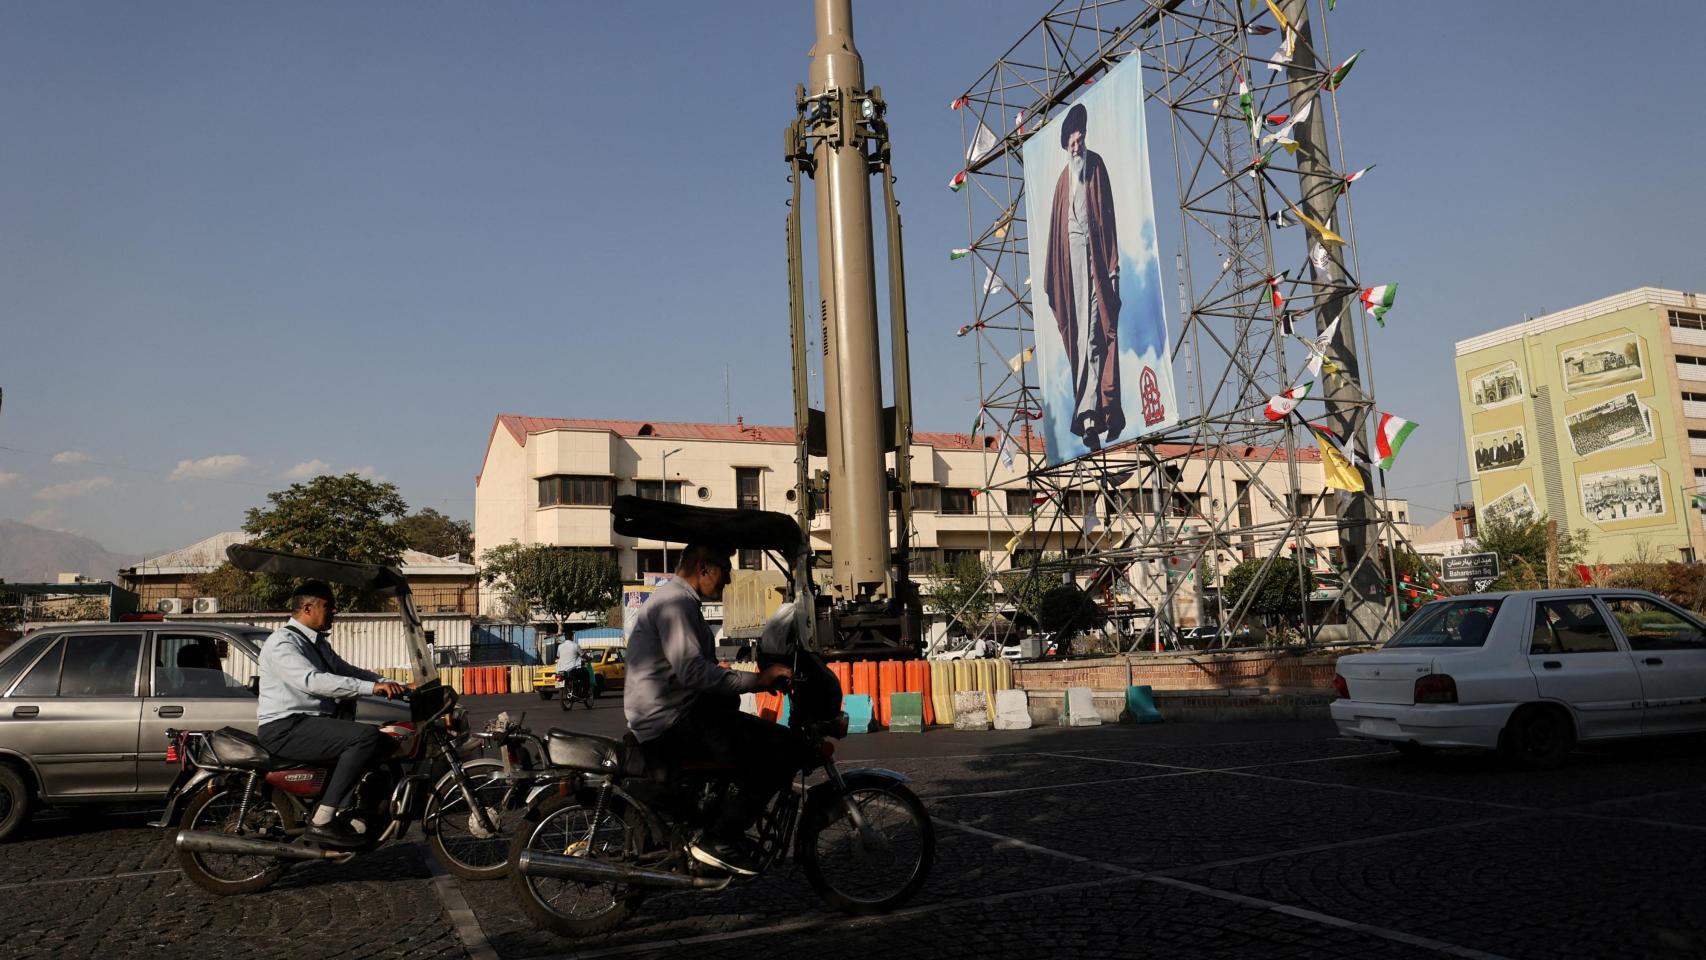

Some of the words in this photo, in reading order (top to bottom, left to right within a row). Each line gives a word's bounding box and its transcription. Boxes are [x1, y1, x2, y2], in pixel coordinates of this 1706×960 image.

[1446, 558, 1473, 567] بهارستان
[1473, 557, 1492, 566] میدان
[1449, 569, 1482, 577] Baharestan
[1482, 568, 1492, 576] Sq
